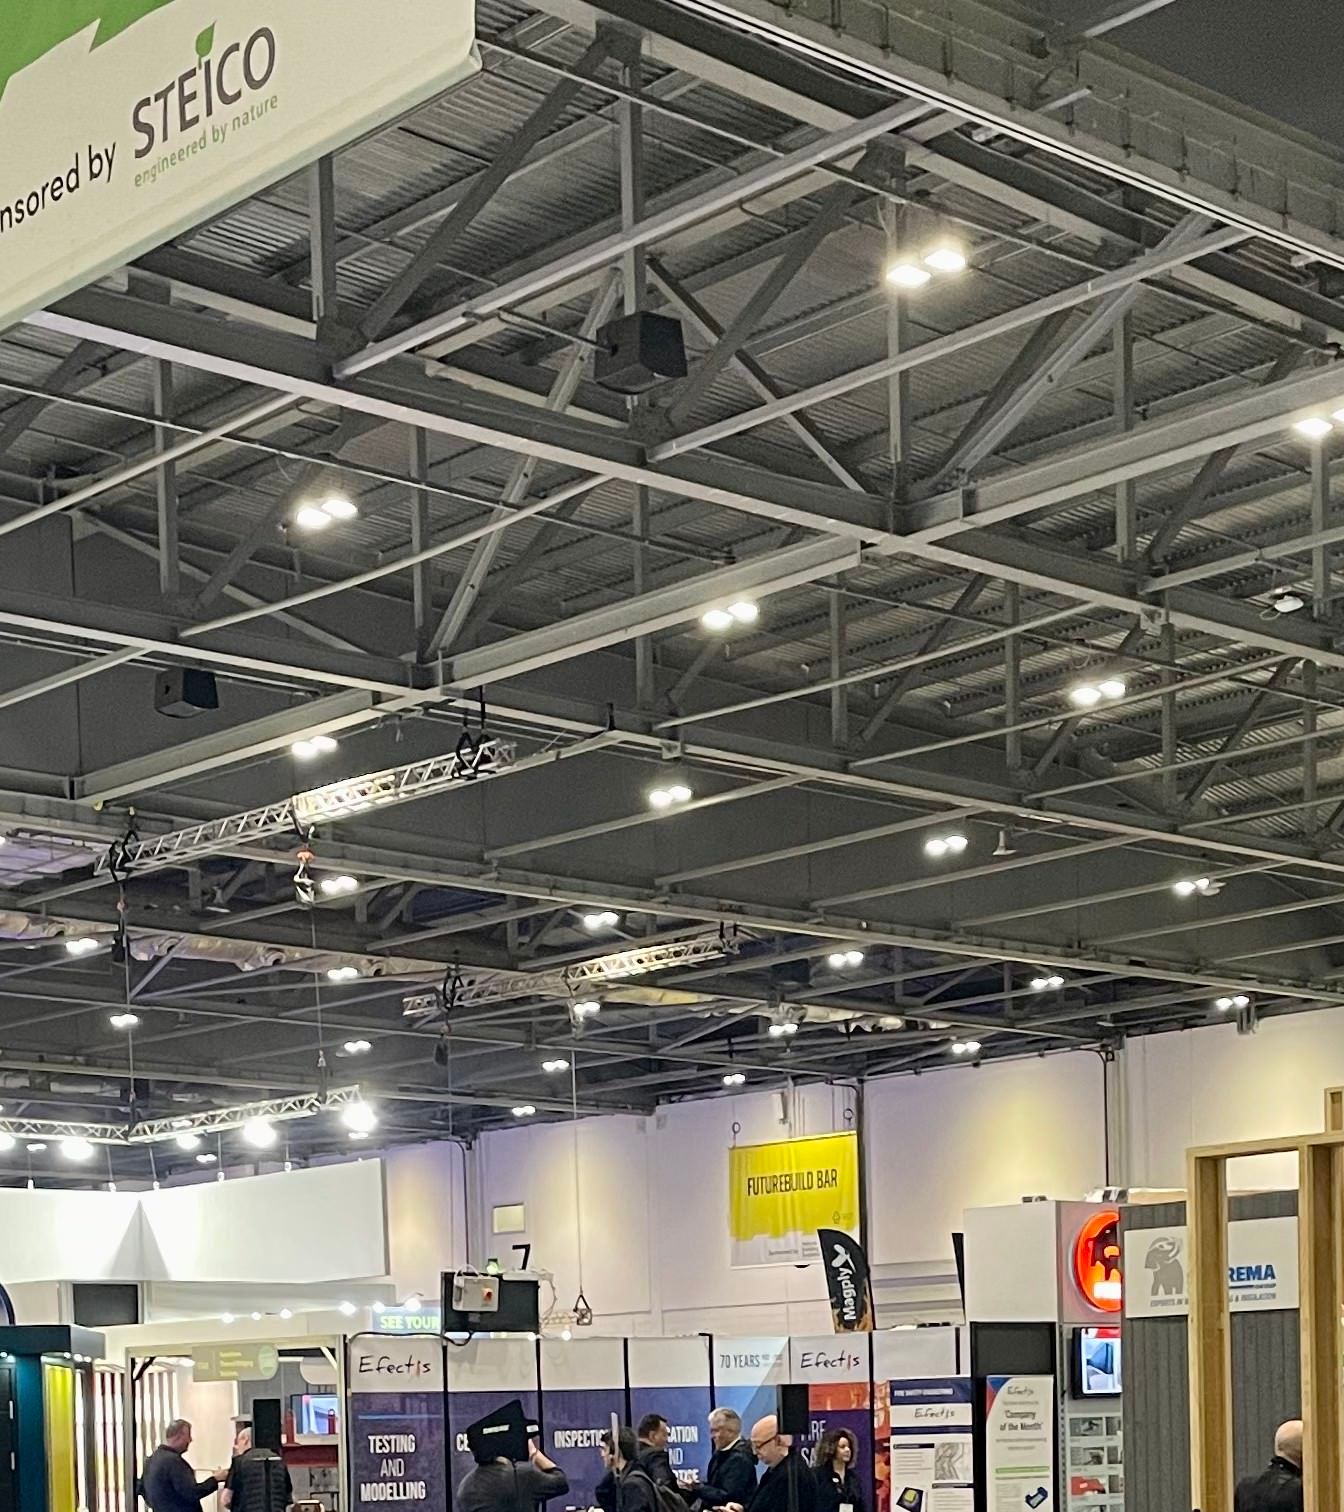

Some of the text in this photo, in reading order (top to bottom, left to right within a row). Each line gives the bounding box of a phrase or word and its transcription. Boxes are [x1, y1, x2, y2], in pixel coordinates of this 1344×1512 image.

[131, 24, 277, 159] STEICO
[134, 94, 279, 188] engineered by nature
[87, 142, 117, 183] by
[747, 1169, 838, 1196] FUTUREBUILD BAR
[512, 1244, 531, 1270] 7
[1229, 1264, 1276, 1282] REMA
[837, 1266, 857, 1321] Magply
[380, 1315, 404, 1329] SEE
[359, 1355, 432, 1374] Efectis
[719, 1354, 731, 1369] 70
[733, 1354, 760, 1368] YEARS
[800, 1352, 860, 1370] Efectis
[368, 1434, 416, 1454] TESTING
[669, 1447, 684, 1465] ND
[380, 1458, 405, 1477] AND
[360, 1480, 426, 1502] MODELLING
